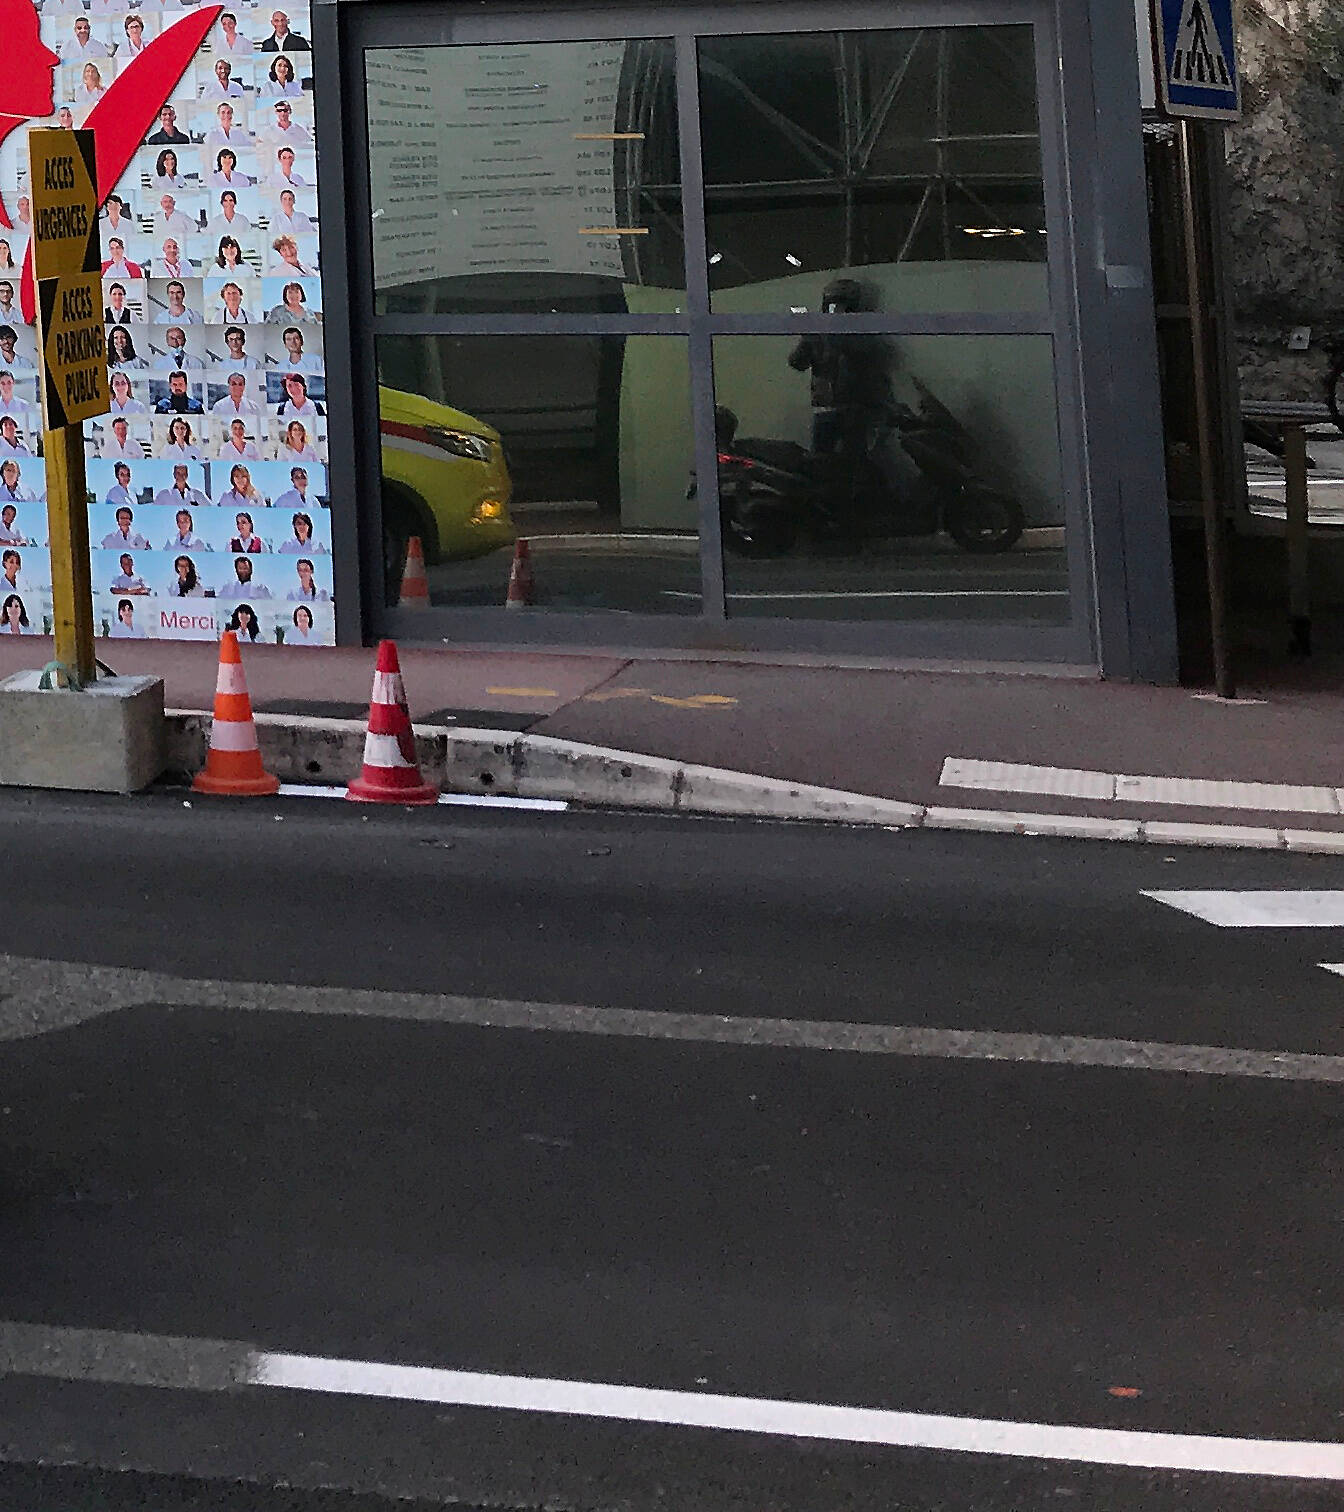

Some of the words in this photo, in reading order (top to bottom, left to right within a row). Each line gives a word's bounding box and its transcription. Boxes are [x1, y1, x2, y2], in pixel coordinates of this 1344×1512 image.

[44, 156, 75, 189] ACCES
[36, 203, 89, 242] URGENCES
[61, 285, 93, 323] ACCES
[56, 324, 103, 366] PARKING
[65, 365, 100, 406] PUBLIC
[160, 610, 214, 630] Merci
